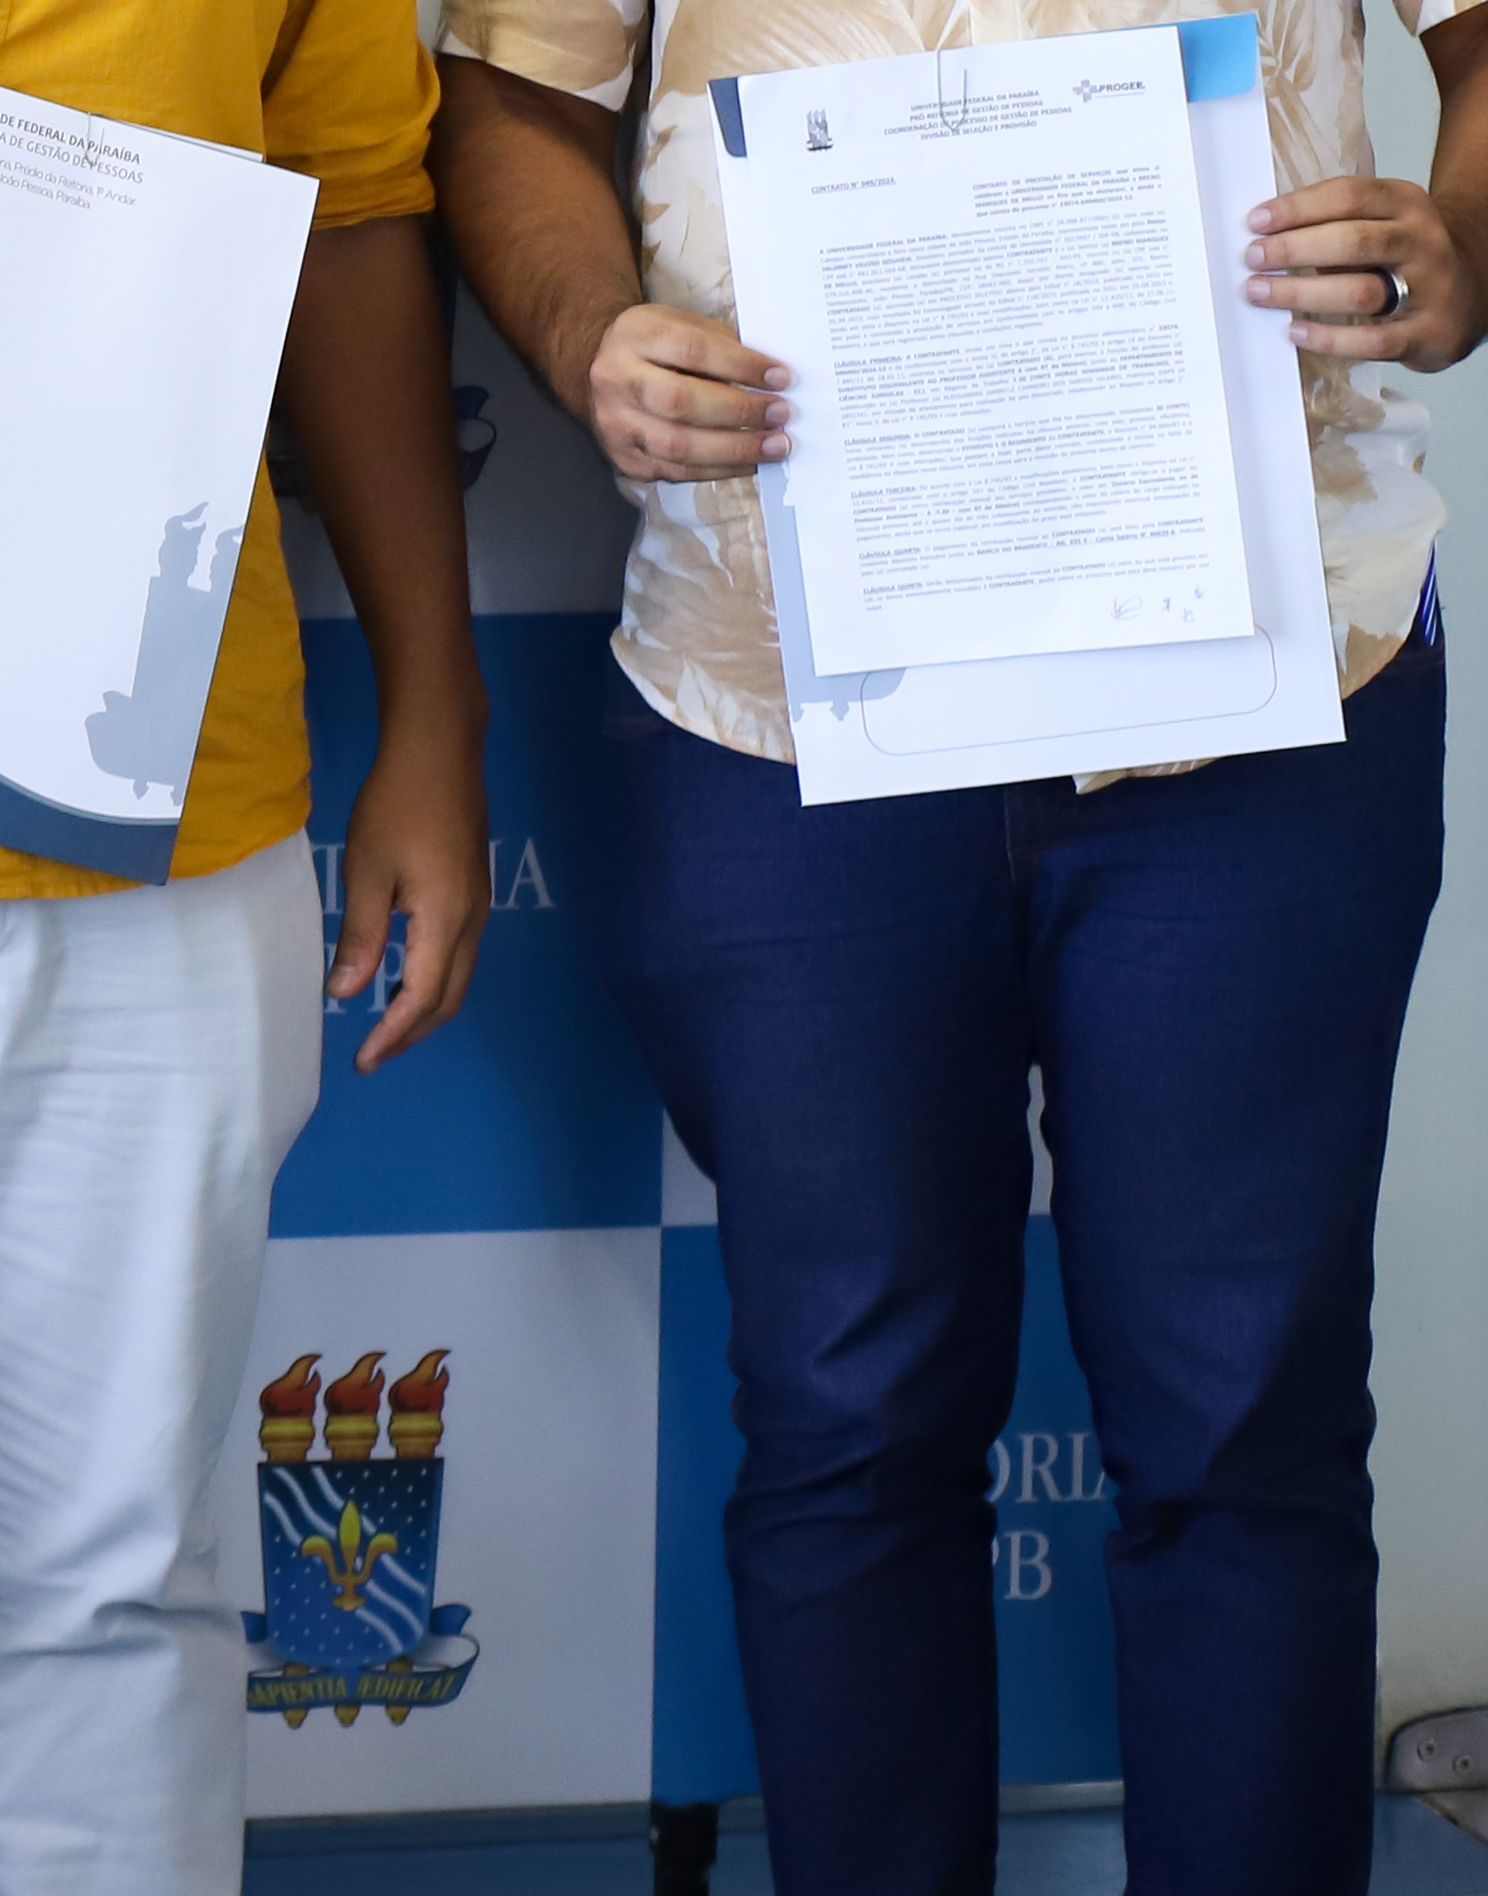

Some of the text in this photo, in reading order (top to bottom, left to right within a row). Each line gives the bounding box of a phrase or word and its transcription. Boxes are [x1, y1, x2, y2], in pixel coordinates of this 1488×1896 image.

[16, 118, 67, 142] FEDERAL
[68, 134, 86, 147] DA
[8, 134, 25, 149] DE
[25, 139, 71, 163] GESTÃO
